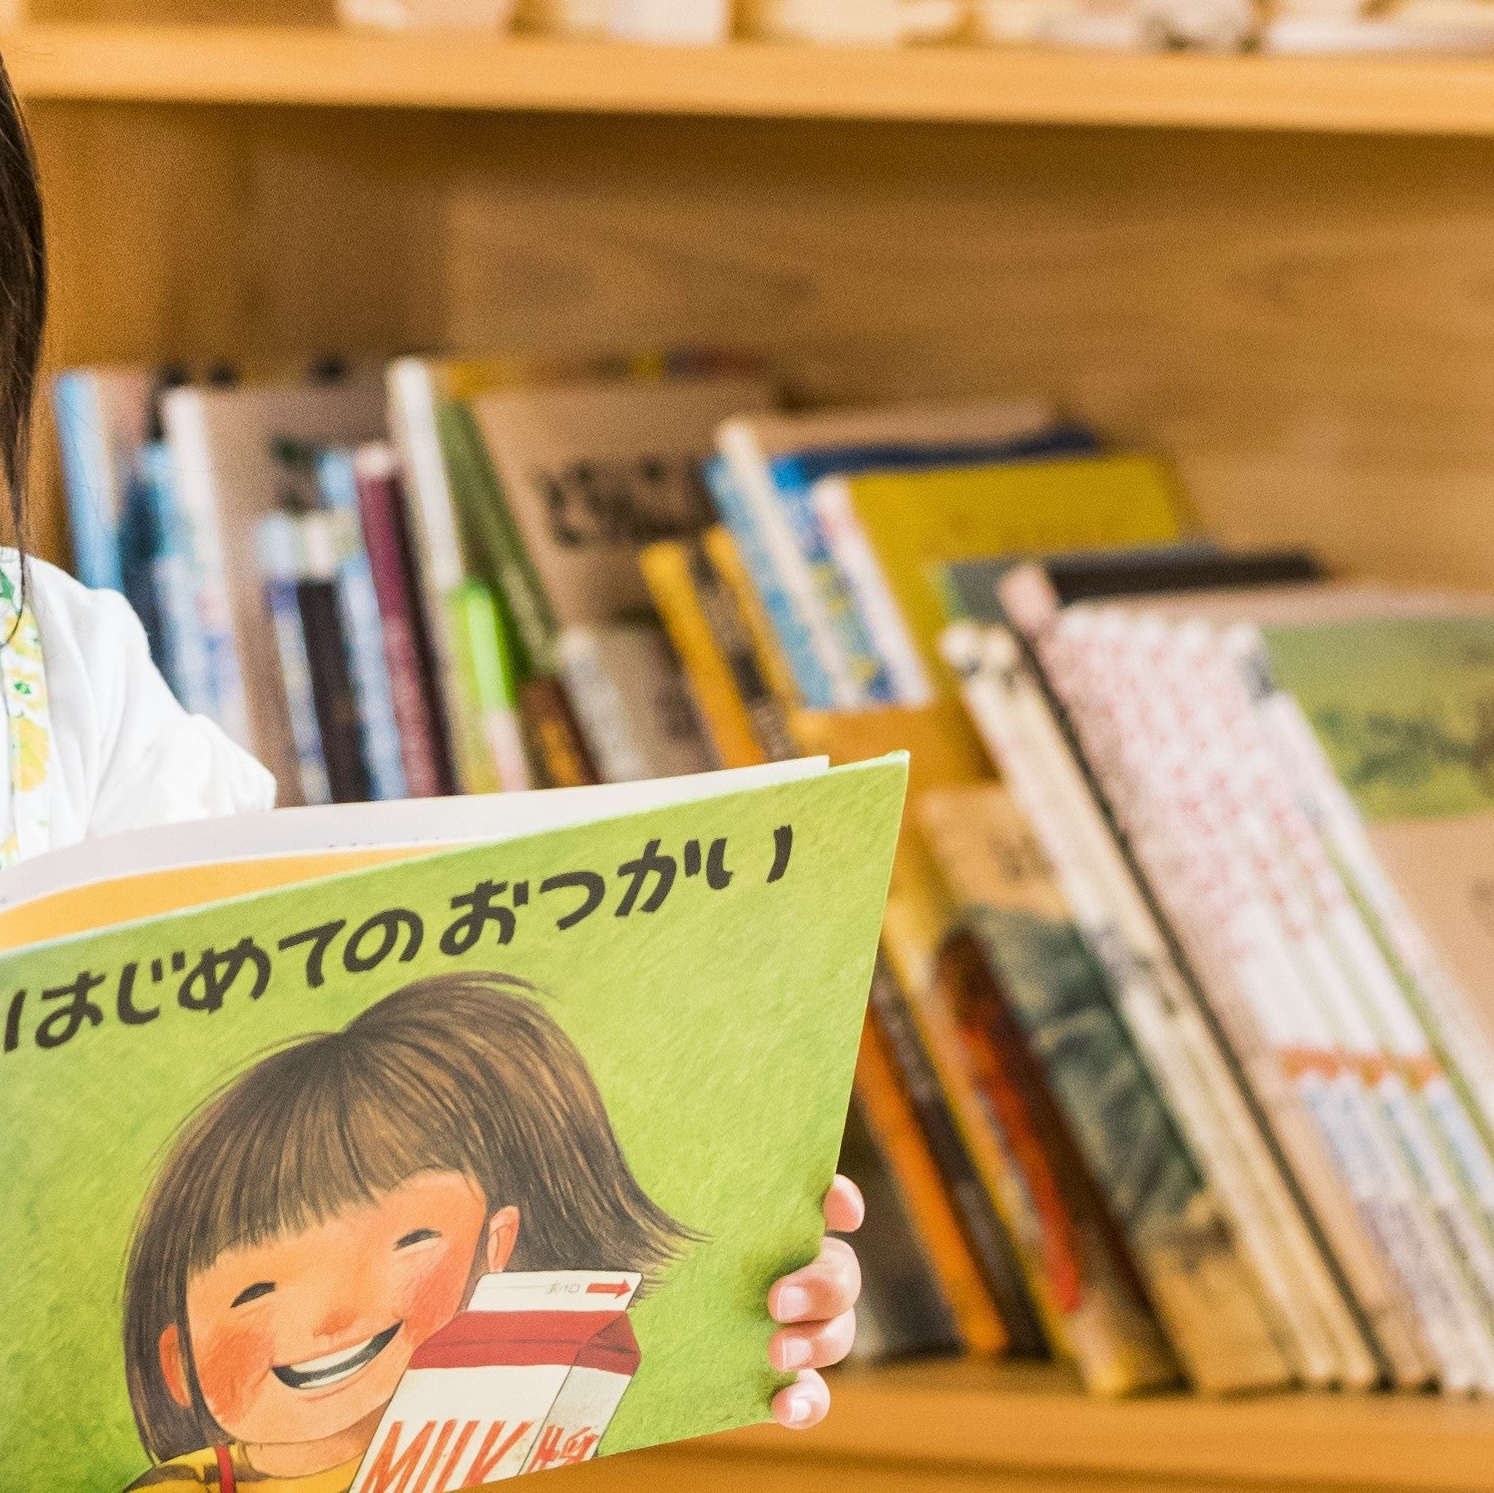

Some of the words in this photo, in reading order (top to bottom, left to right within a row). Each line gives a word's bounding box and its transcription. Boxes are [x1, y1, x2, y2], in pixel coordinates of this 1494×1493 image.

[2, 823, 795, 1054] はじめてのおつかい
